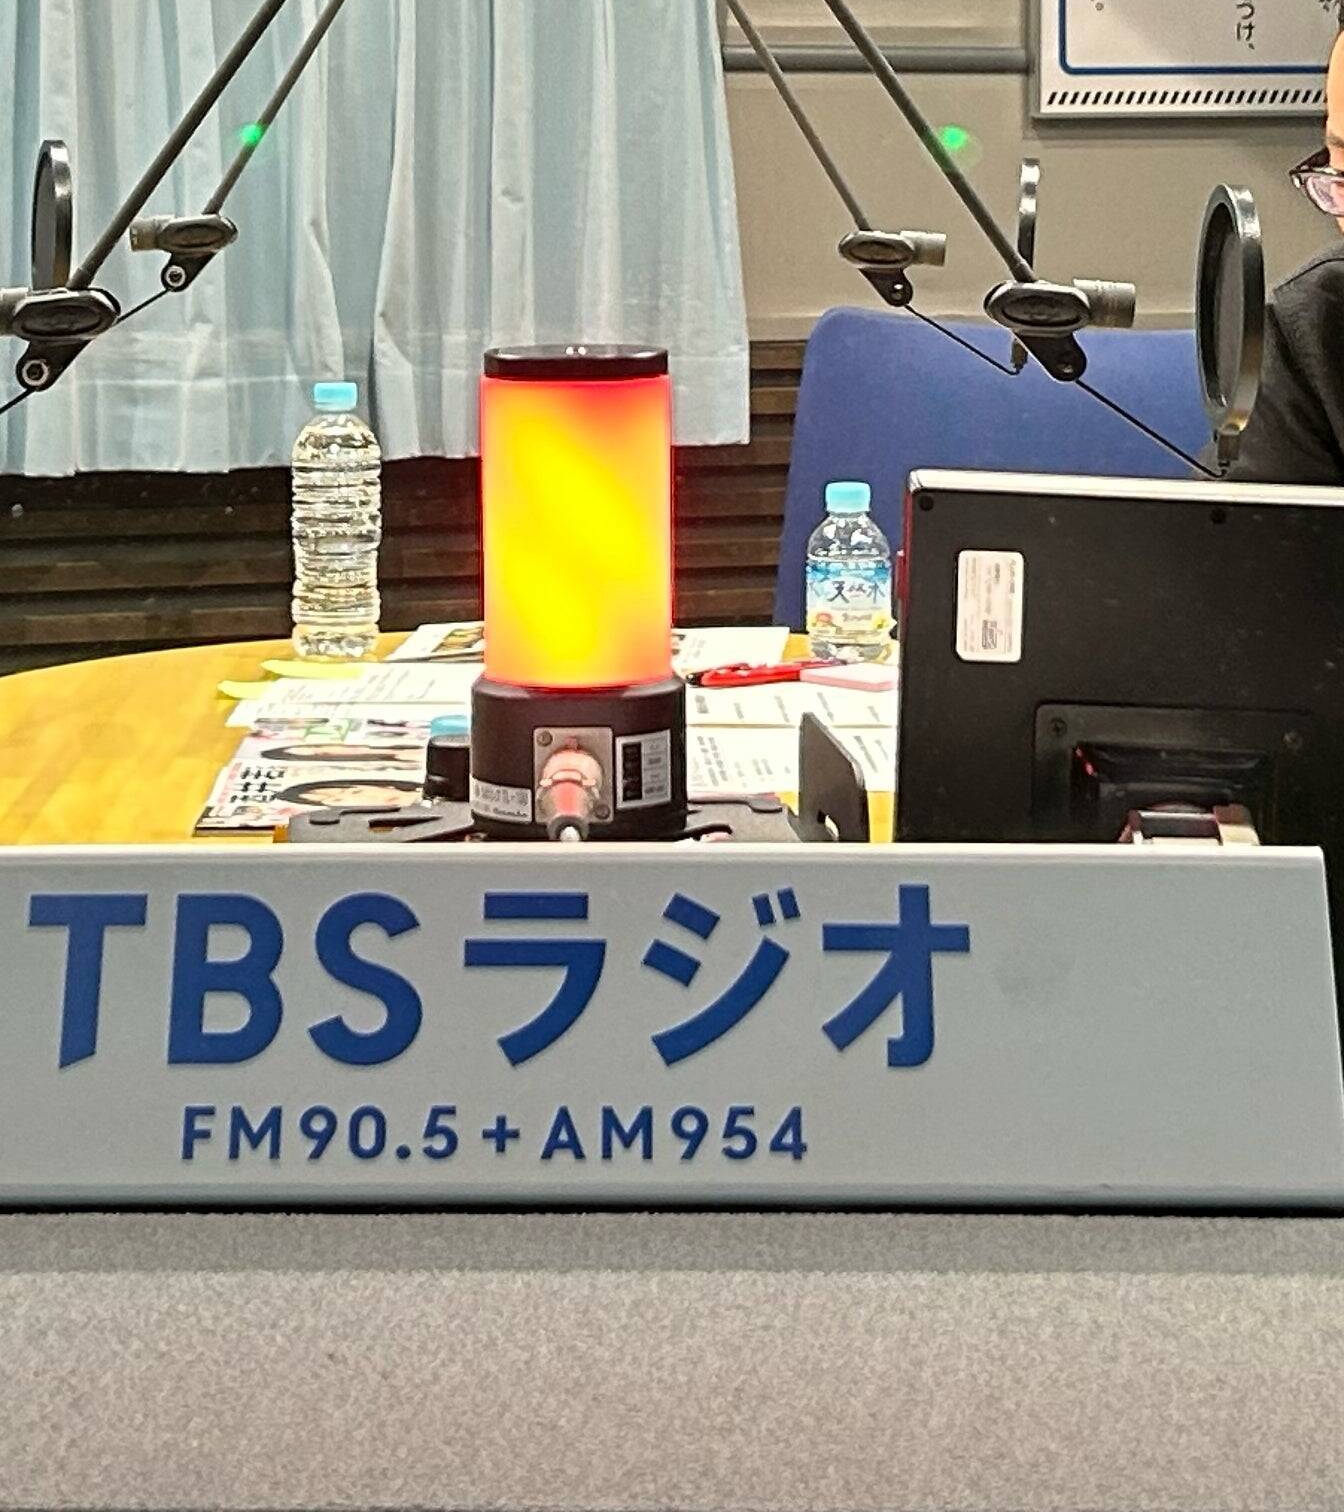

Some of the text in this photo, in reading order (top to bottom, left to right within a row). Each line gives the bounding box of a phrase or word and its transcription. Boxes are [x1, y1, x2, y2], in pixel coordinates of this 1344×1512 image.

[28, 883, 972, 1070] TBSラジオ
[181, 1105, 808, 1161] FM90.5+AM954
